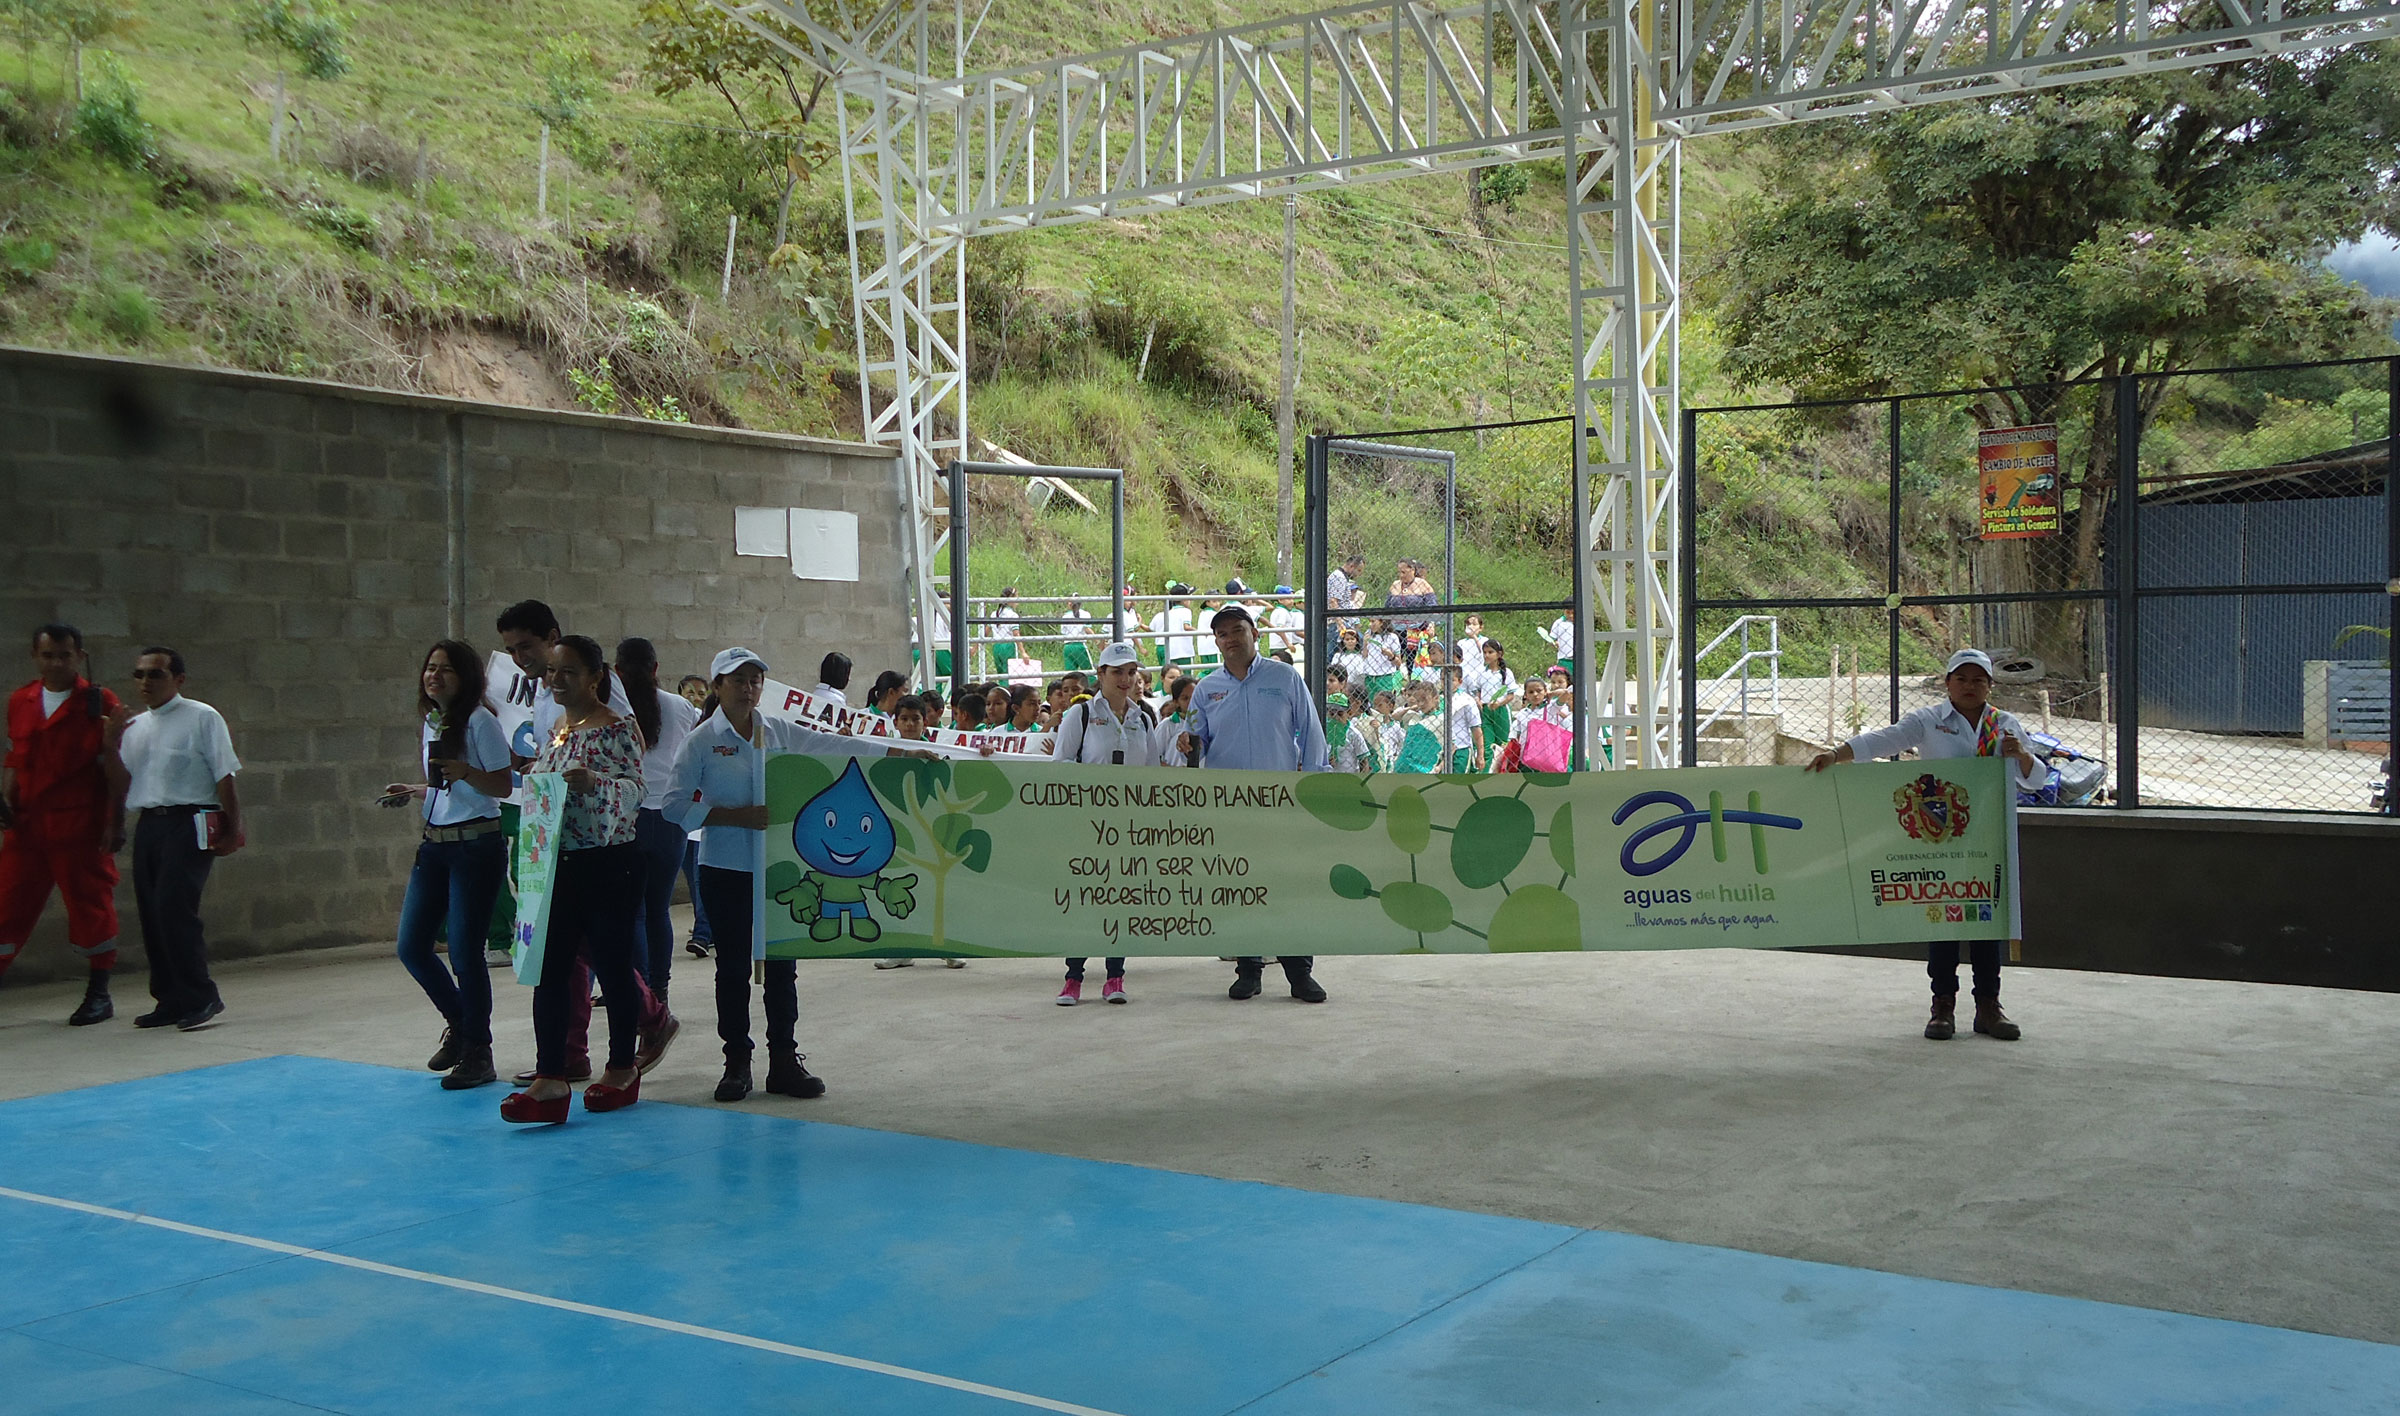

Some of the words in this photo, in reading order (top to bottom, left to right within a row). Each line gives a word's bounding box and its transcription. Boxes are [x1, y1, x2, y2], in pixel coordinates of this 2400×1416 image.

[1983, 459, 2012, 472] CAMBIO
[2013, 458, 2025, 469] DE
[2026, 454, 2056, 469] ACEITE
[1982, 507, 2010, 519] Servicio
[2010, 507, 2019, 517] de
[2020, 505, 2057, 517] Soldadura
[1987, 521, 2015, 533] Pintura
[2016, 522, 2026, 532] en
[2026, 518, 2057, 531] General
[783, 689, 888, 738] PLANTA
[1019, 783, 1119, 808] CUIDEMOS
[1125, 784, 1207, 808] NUESTRO
[1213, 783, 1295, 808] PLANETA
[1090, 819, 1119, 845] Yo
[1127, 819, 1215, 846] también
[1068, 856, 1110, 884] soy
[1120, 855, 1148, 876] un
[1201, 853, 1249, 876] vivo
[1870, 869, 1886, 884] El
[1890, 867, 1946, 882] camino
[1054, 886, 1071, 914] y
[1079, 879, 1171, 906] necesito
[1179, 879, 1203, 906] tu
[1623, 888, 1692, 909] aguas
[1695, 888, 1715, 901] del
[1718, 883, 1776, 903] huila
[1872, 884, 1881, 894] la
[1874, 894, 1882, 907] es
[1880, 875, 1992, 902] EDUCACIÓN
[1103, 917, 1119, 944] y
[1690, 912, 1716, 926] más
[1718, 914, 1741, 931] que
[1743, 913, 1779, 930] agua.
